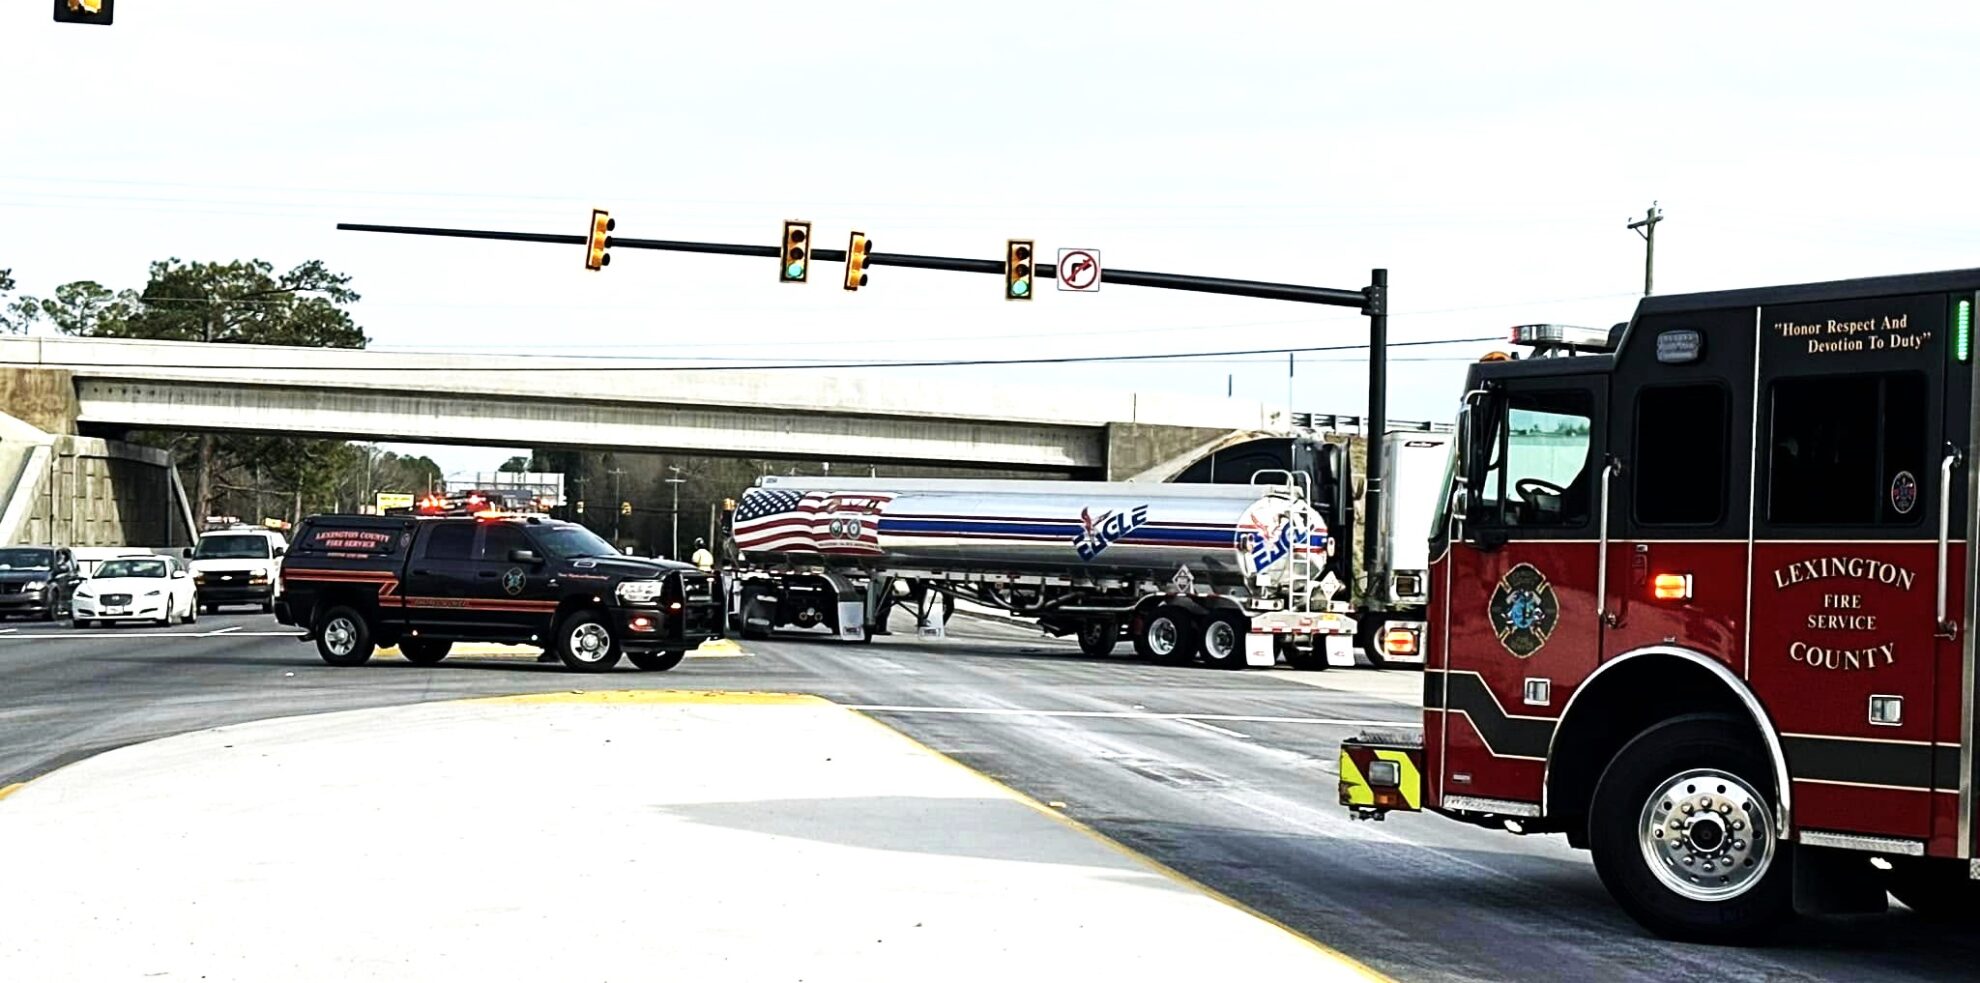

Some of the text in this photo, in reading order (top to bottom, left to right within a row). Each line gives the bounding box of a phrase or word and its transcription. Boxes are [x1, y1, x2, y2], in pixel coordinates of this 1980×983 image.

[1774, 314, 1908, 337] "Honor Respect And
[1807, 331, 1932, 354] Devotion To Duty"
[315, 530, 390, 543] LEXINGTON COUNTY
[1073, 504, 1149, 561] EAGLE
[325, 540, 377, 549] FIRE SERVICE
[1774, 556, 1917, 590] LEXINGTON
[1823, 593, 1862, 609] FIRE
[1807, 614, 1877, 631] SERVICE
[1789, 641, 1895, 671] COUNTY
